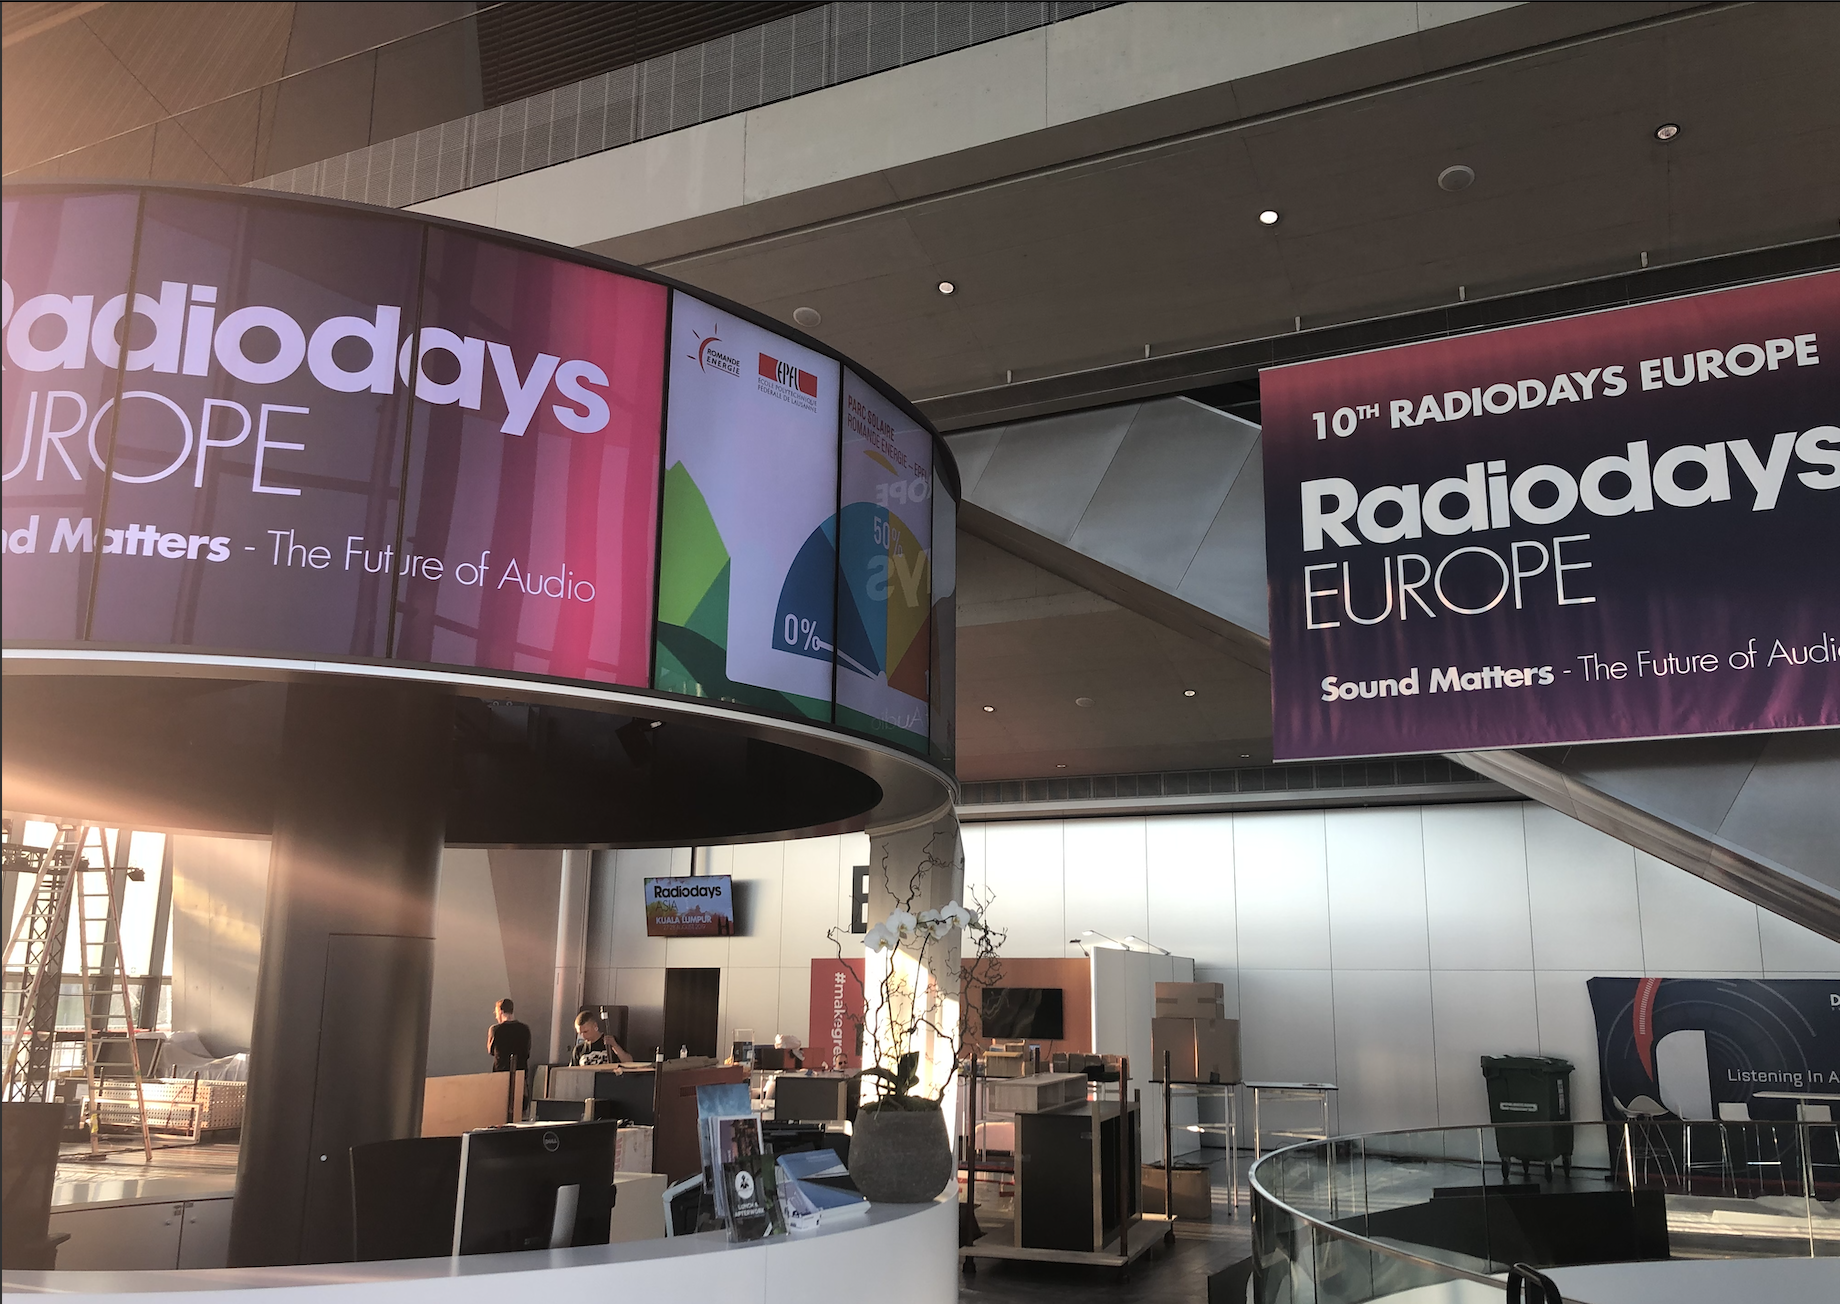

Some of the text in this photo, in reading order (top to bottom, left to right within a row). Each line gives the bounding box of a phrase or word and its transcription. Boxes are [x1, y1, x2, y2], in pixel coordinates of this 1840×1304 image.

[706, 348, 740, 367] ROMANDE
[777, 361, 799, 391] EPFL
[1312, 332, 1820, 440] 10TH RADIODAYS EUROPE
[847, 413, 880, 449] ROMANDE
[848, 395, 895, 442] PARC SOLAIRE
[1301, 425, 1840, 552] Radiodays
[874, 515, 904, 558] 50%
[50, 517, 231, 563] Matters
[268, 530, 331, 571] The
[344, 536, 444, 582] Future
[455, 551, 490, 588] of
[498, 563, 596, 604] Audio
[1304, 534, 1597, 631] EUROPE
[784, 613, 822, 651] 0%
[1320, 667, 1420, 702] Sound
[1429, 663, 1554, 694] Matters
[1577, 654, 1628, 682] The
[1637, 650, 1719, 678] Future
[1729, 639, 1758, 669] of
[1767, 632, 1840, 668] Audi
[654, 885, 722, 899] Radiodays
[655, 900, 678, 912] ASIA
[656, 915, 712, 925] KUALA LUMPUR
[1727, 1069, 1803, 1088] Listening
[1808, 1070, 1823, 1083] In
